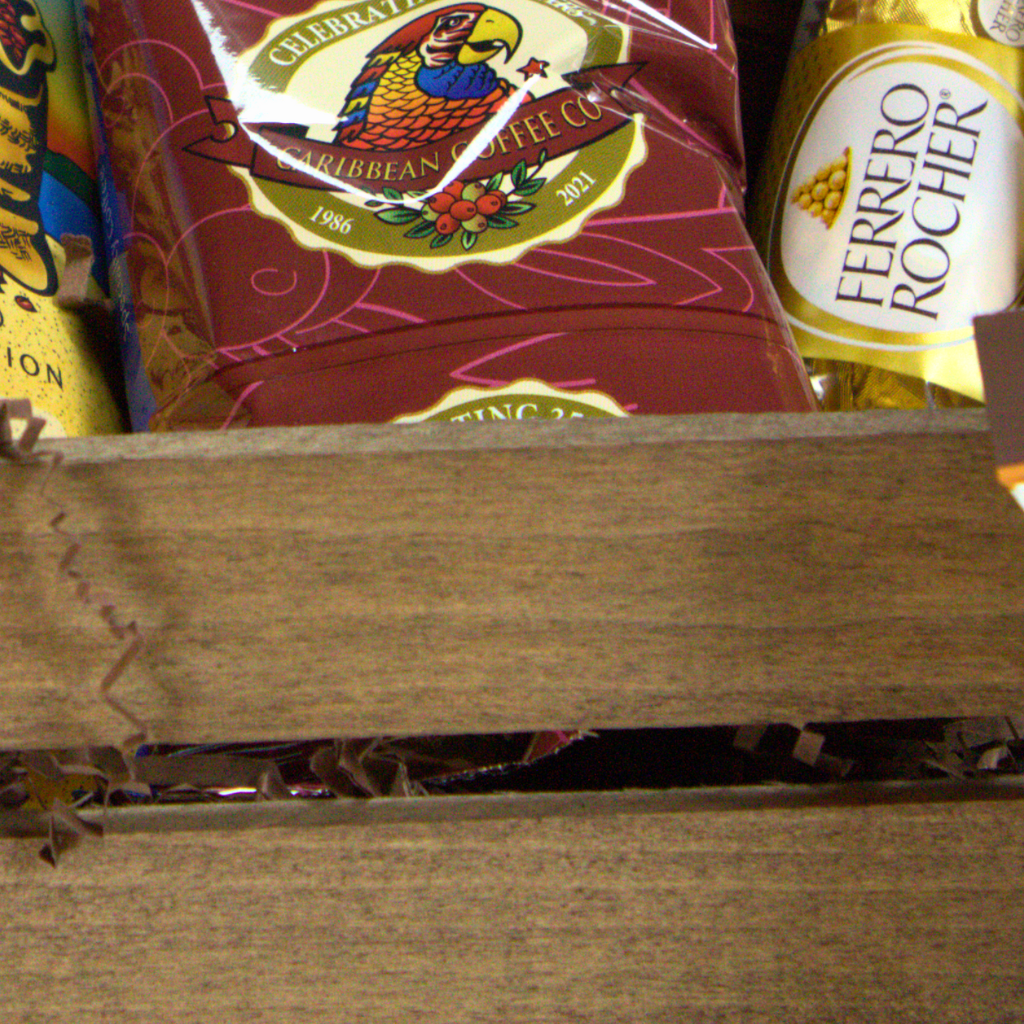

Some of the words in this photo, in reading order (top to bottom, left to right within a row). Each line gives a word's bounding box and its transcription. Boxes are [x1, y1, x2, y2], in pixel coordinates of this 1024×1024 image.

[276, 145, 440, 182] CARIBBEAN
[451, 110, 562, 169] COFFEE
[555, 170, 597, 207] 2021
[835, 82, 930, 306] FERRERO
[309, 205, 353, 235] 1986
